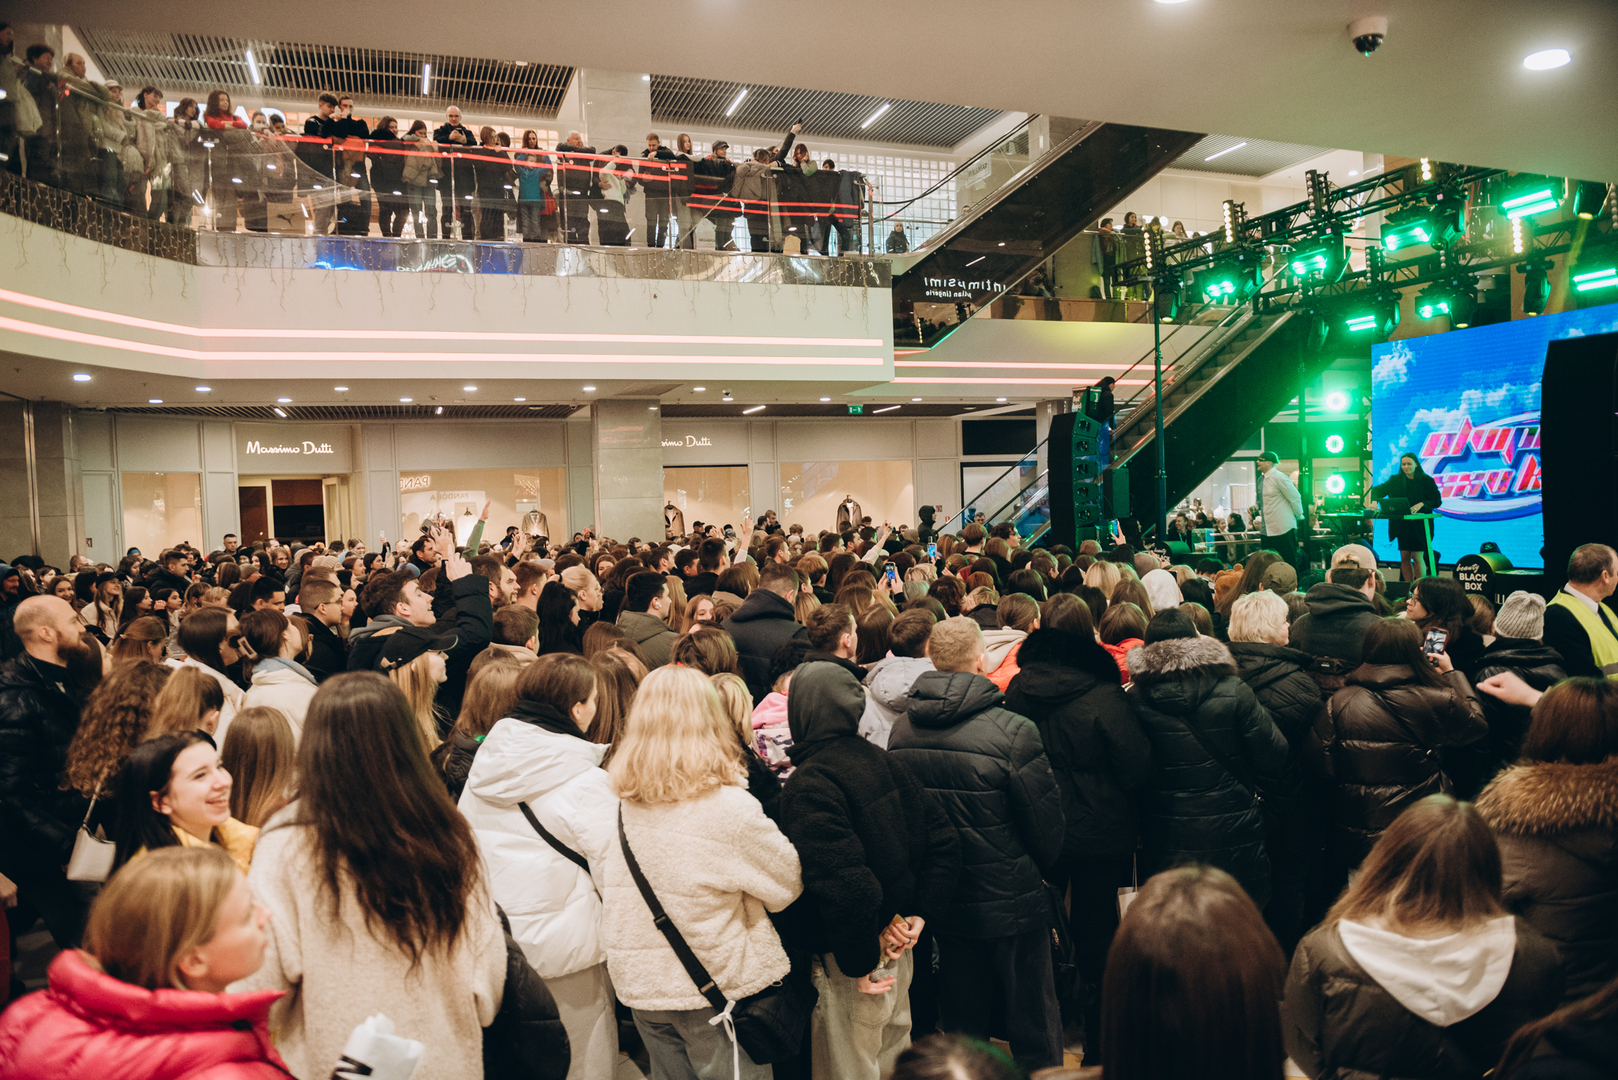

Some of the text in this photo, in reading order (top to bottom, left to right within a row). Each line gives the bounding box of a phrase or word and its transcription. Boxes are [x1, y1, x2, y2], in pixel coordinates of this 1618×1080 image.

[685, 435, 712, 447] Dutti
[246, 440, 334, 455] Massimo Dutti
[1456, 563, 1480, 574] beauty
[1459, 573, 1488, 582] BLACK
[1464, 582, 1483, 591] BOX
